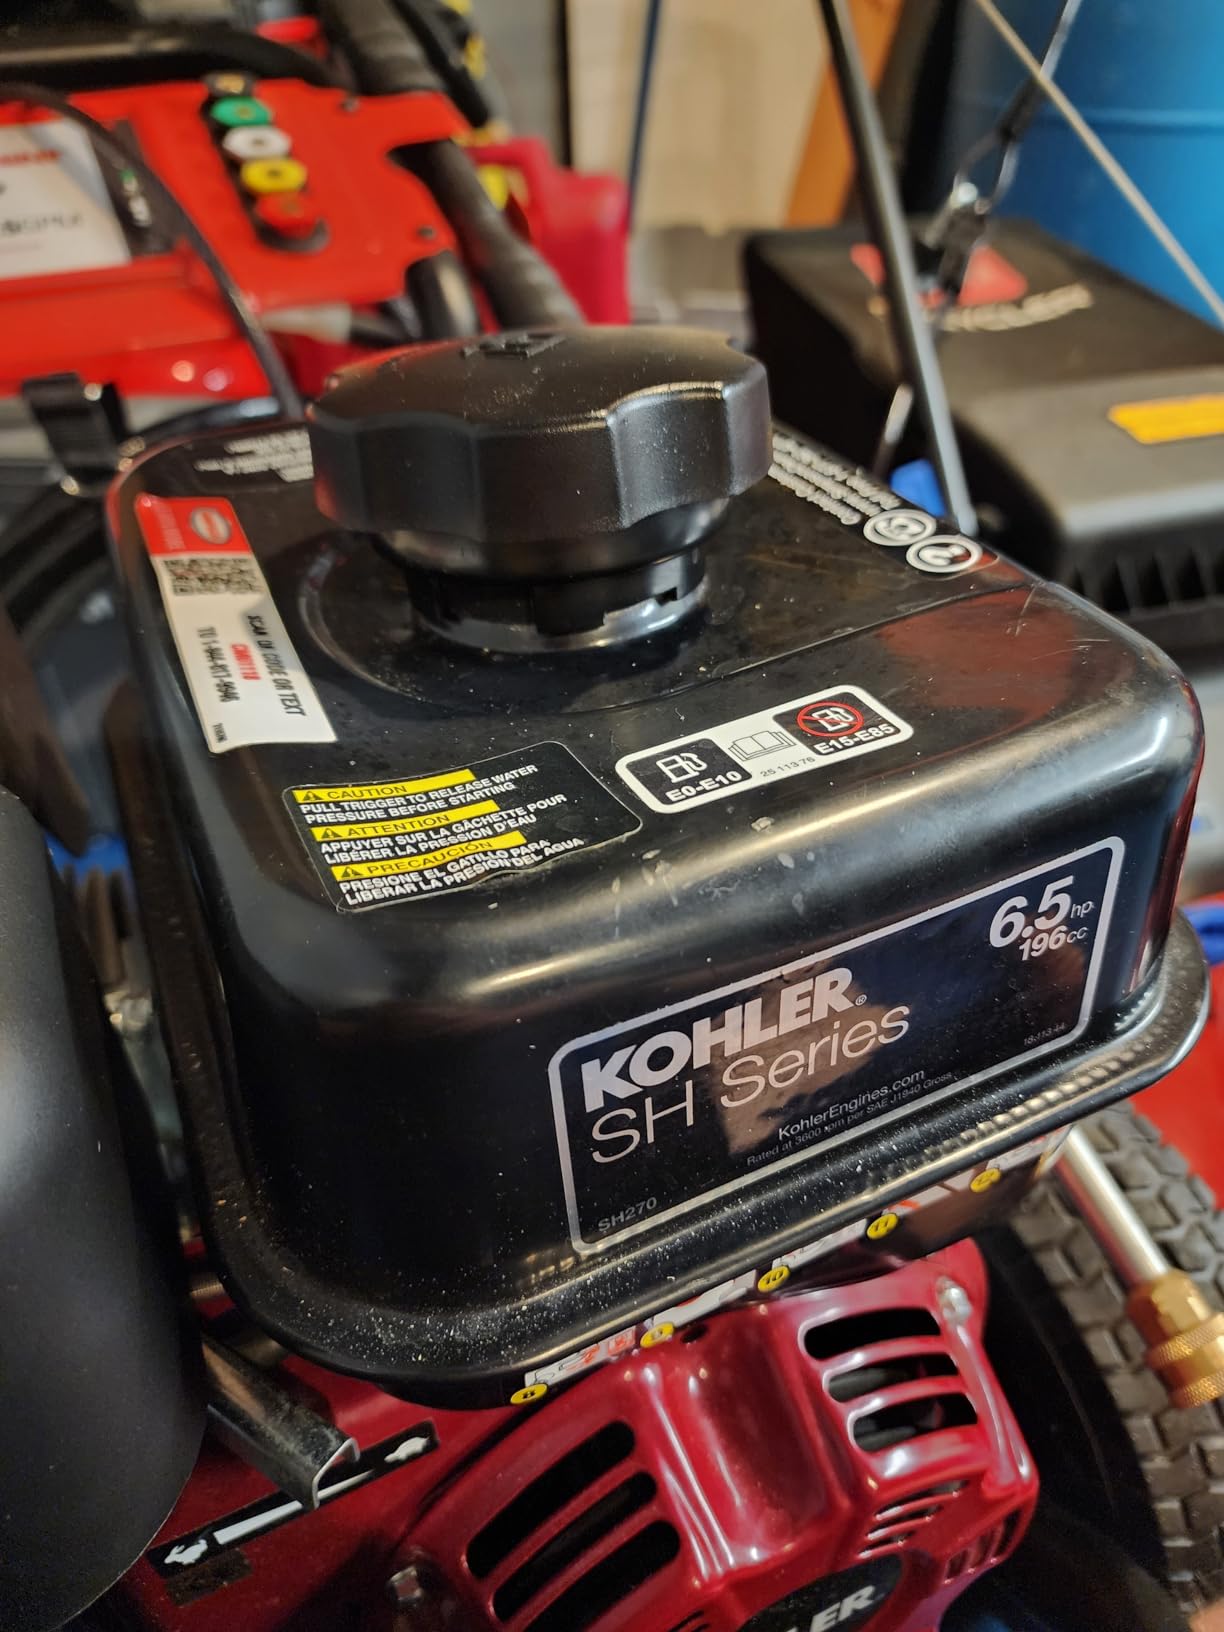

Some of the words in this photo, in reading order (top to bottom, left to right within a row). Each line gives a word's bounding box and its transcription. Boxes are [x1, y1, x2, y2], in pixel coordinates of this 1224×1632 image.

[261, 653, 289, 675] CODE
[272, 678, 295, 691] OR
[278, 692, 306, 716] TEXT
[813, 723, 896, 754] E15-E85
[665, 771, 742, 802] E0-E10
[760, 768, 777, 778] 25
[777, 761, 800, 772] 113
[300, 801, 342, 814] PULL
[342, 795, 409, 811] TRIGGER
[405, 794, 427, 804] TO
[430, 777, 492, 800] RELEASE
[491, 764, 538, 783] WATER
[304, 809, 387, 824] PRESSURE
[389, 799, 448, 817] BEFORE
[449, 781, 516, 805] STARTING
[327, 785, 408, 799] CAUTION
[321, 836, 394, 854] APPUYER
[396, 831, 428, 846] SUR
[429, 828, 451, 840] LA
[527, 793, 567, 813] POUR
[347, 815, 450, 837] ATTENTION
[395, 844, 418, 860] LA
[418, 826, 494, 852] PRESSION
[494, 813, 537, 833] D'EAU
[339, 872, 422, 894] PRESIONE
[426, 867, 446, 879] EL
[446, 849, 509, 873] GATILLO
[509, 839, 551, 856] PARA
[345, 883, 417, 905] LIBERAR
[418, 877, 443, 892] LA
[511, 853, 543, 867] DEL
[543, 837, 585, 856] AGUA
[367, 841, 492, 874] PRECAUCIÓN
[591, 1079, 694, 1164] SH
[720, 1006, 910, 1108] Series
[747, 1144, 779, 1167] Rated
[781, 1140, 793, 1151] at
[795, 1127, 822, 1146] 3600
[847, 1109, 865, 1124] per
[866, 1098, 889, 1114] SAE
[890, 1084, 921, 1104] J1940
[922, 1071, 953, 1089] Gross
[778, 1070, 926, 1141] KohlerEngines.com
[598, 1196, 657, 1232] SH270
[764, 1269, 784, 1285] 10
[786, 1585, 876, 1632] ER
